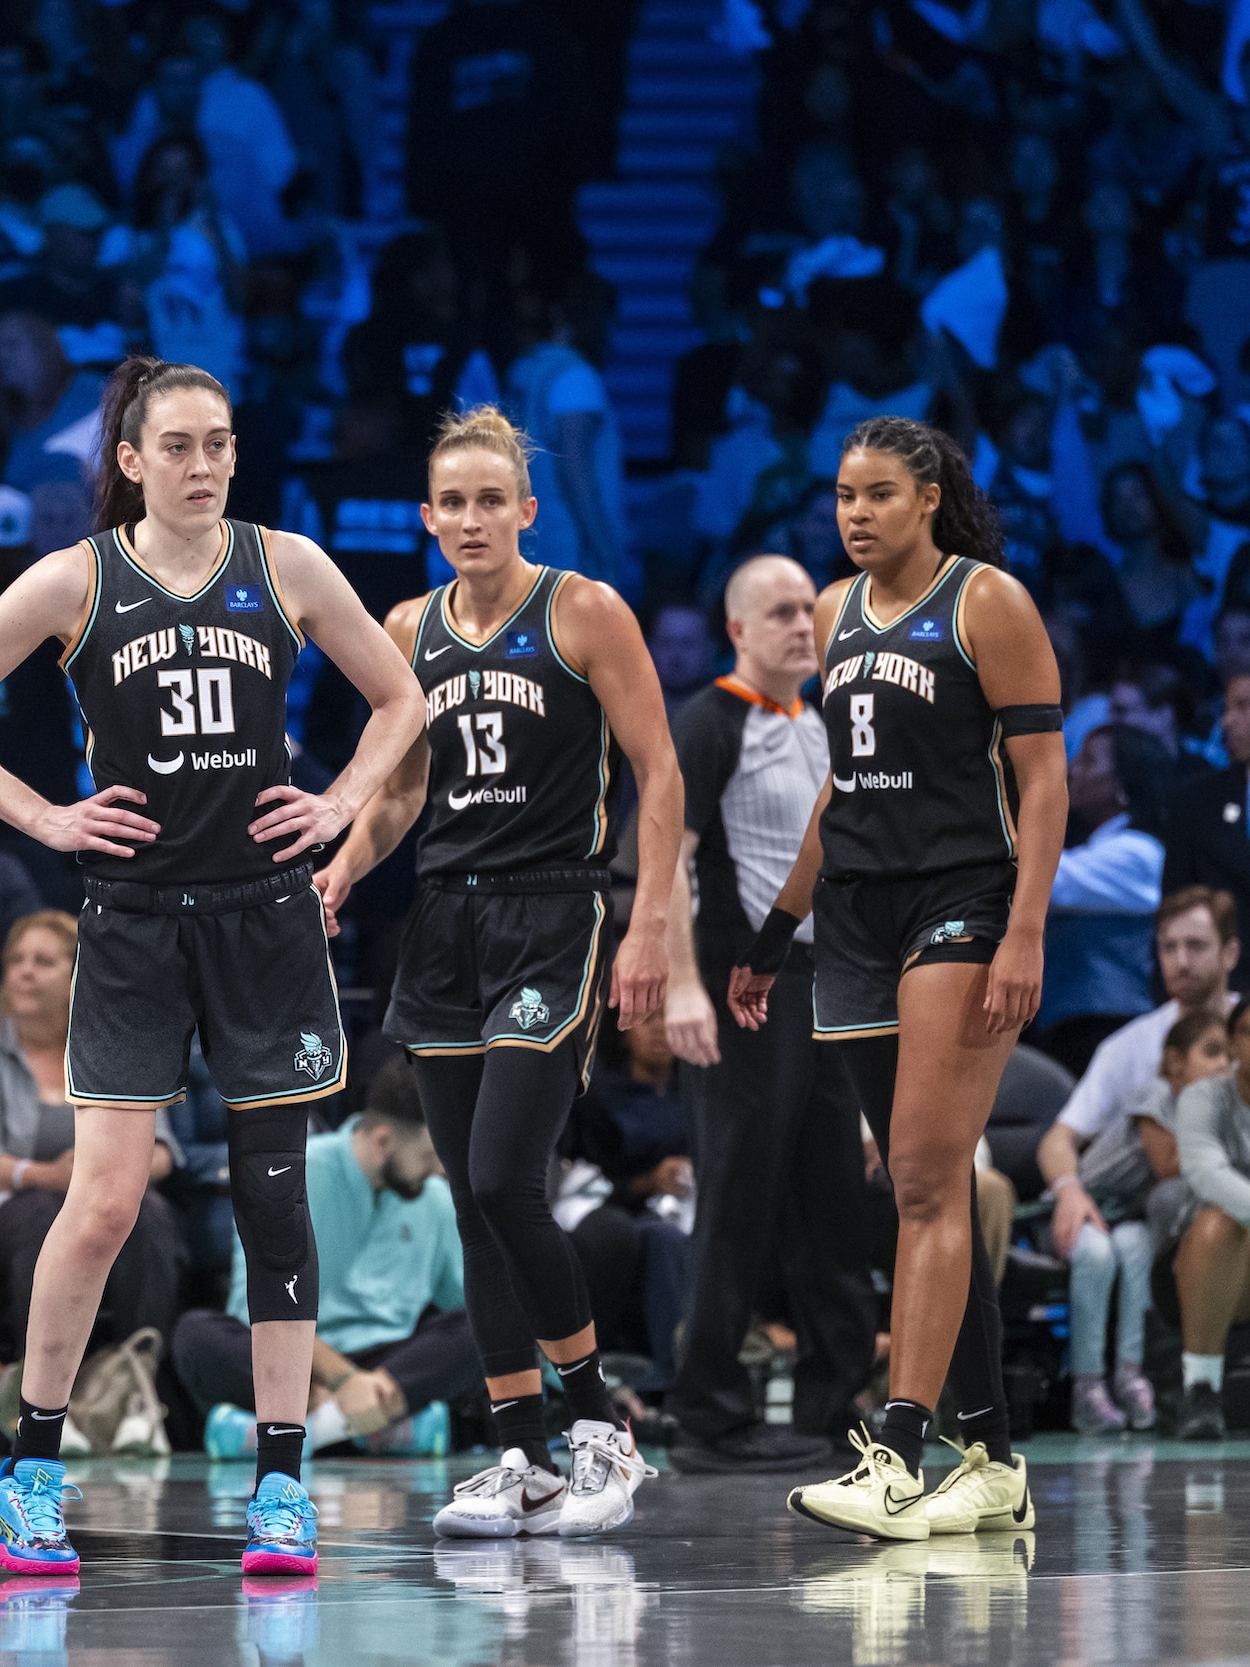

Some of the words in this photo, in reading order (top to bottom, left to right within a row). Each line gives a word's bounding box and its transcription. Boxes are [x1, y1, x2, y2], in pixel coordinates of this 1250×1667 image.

[229, 601, 259, 609] BARCLAYS
[111, 626, 178, 687] NEW
[196, 626, 272, 681] YORK
[911, 630, 939, 639] BARCLAYS
[157, 667, 236, 737] 30
[425, 673, 467, 730] NEW
[482, 670, 546, 718] YORK
[871, 652, 936, 704] YORK
[457, 711, 508, 777] 13
[850, 693, 876, 758] 8
[191, 748, 257, 771] Webull
[858, 771, 913, 790] Webull
